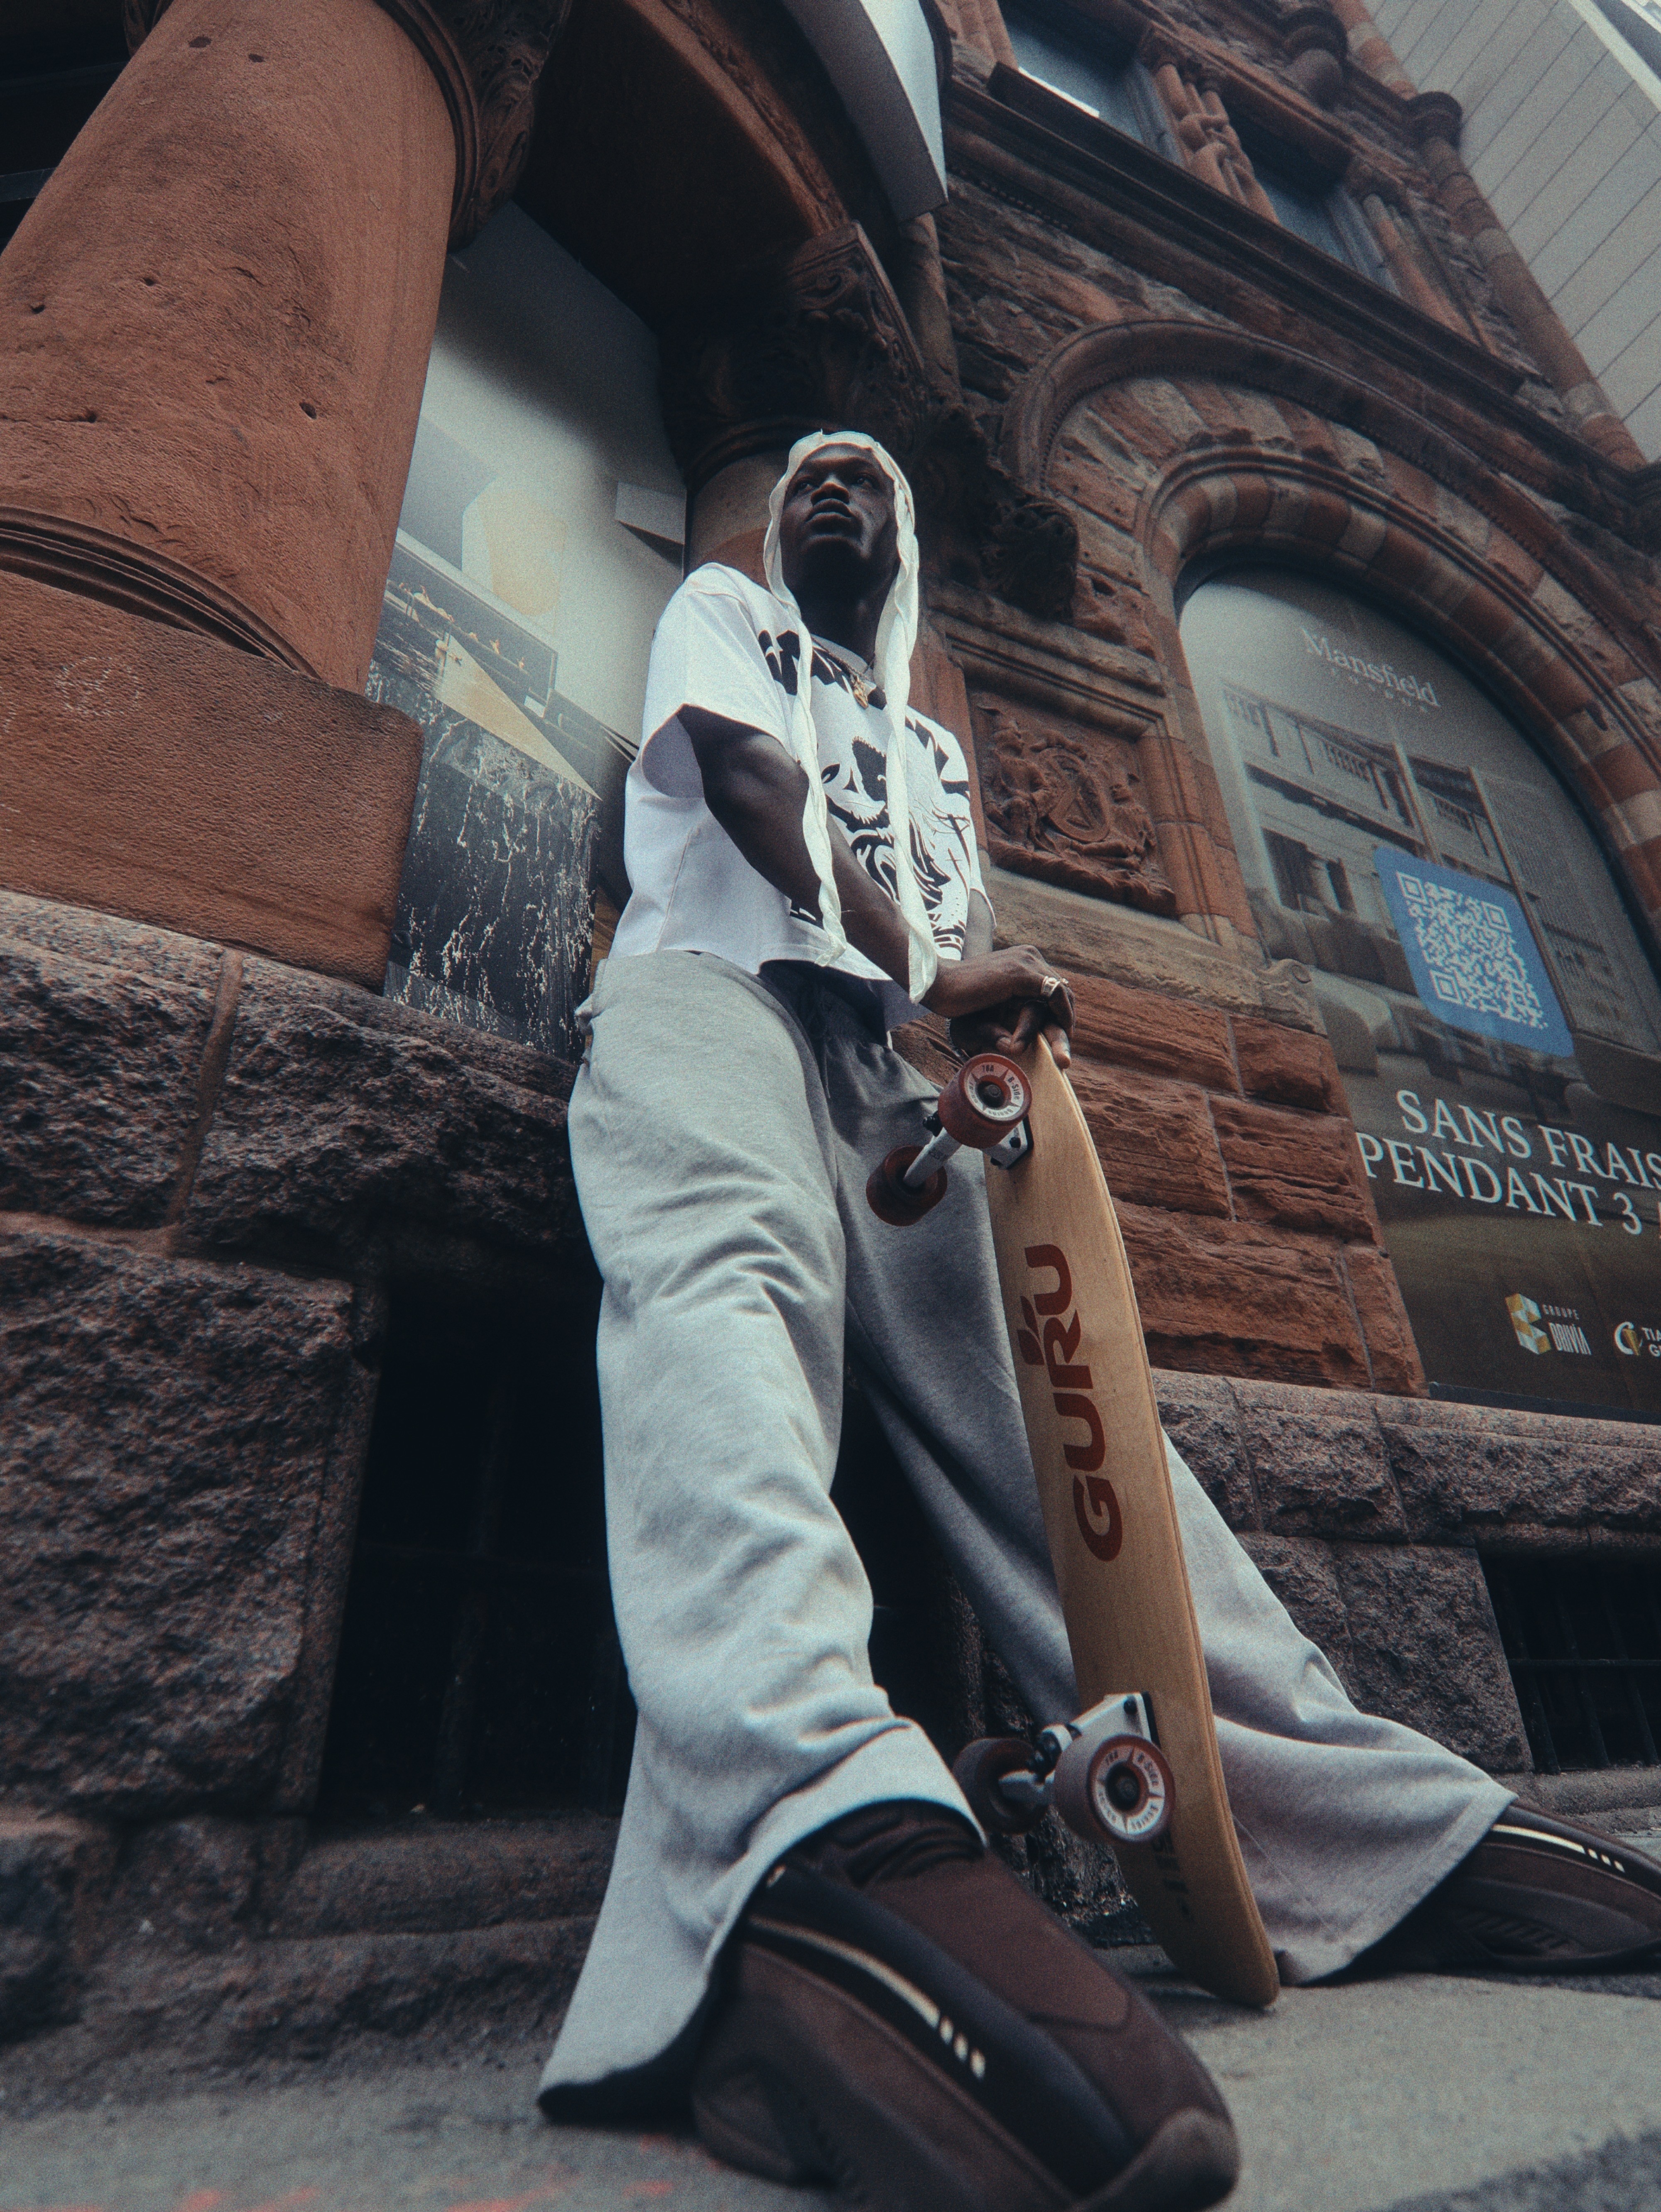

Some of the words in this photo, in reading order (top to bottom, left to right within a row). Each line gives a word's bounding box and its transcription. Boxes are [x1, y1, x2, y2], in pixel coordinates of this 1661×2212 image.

[1298, 627, 1441, 707] Mansfield
[1396, 1090, 1532, 1159] SANS
[1355, 1132, 1603, 1227] PENDANT
[1613, 1192, 1642, 1235] 3
[1542, 1304, 1579, 1320] GROUPE
[1024, 1244, 1122, 1562] GURU
